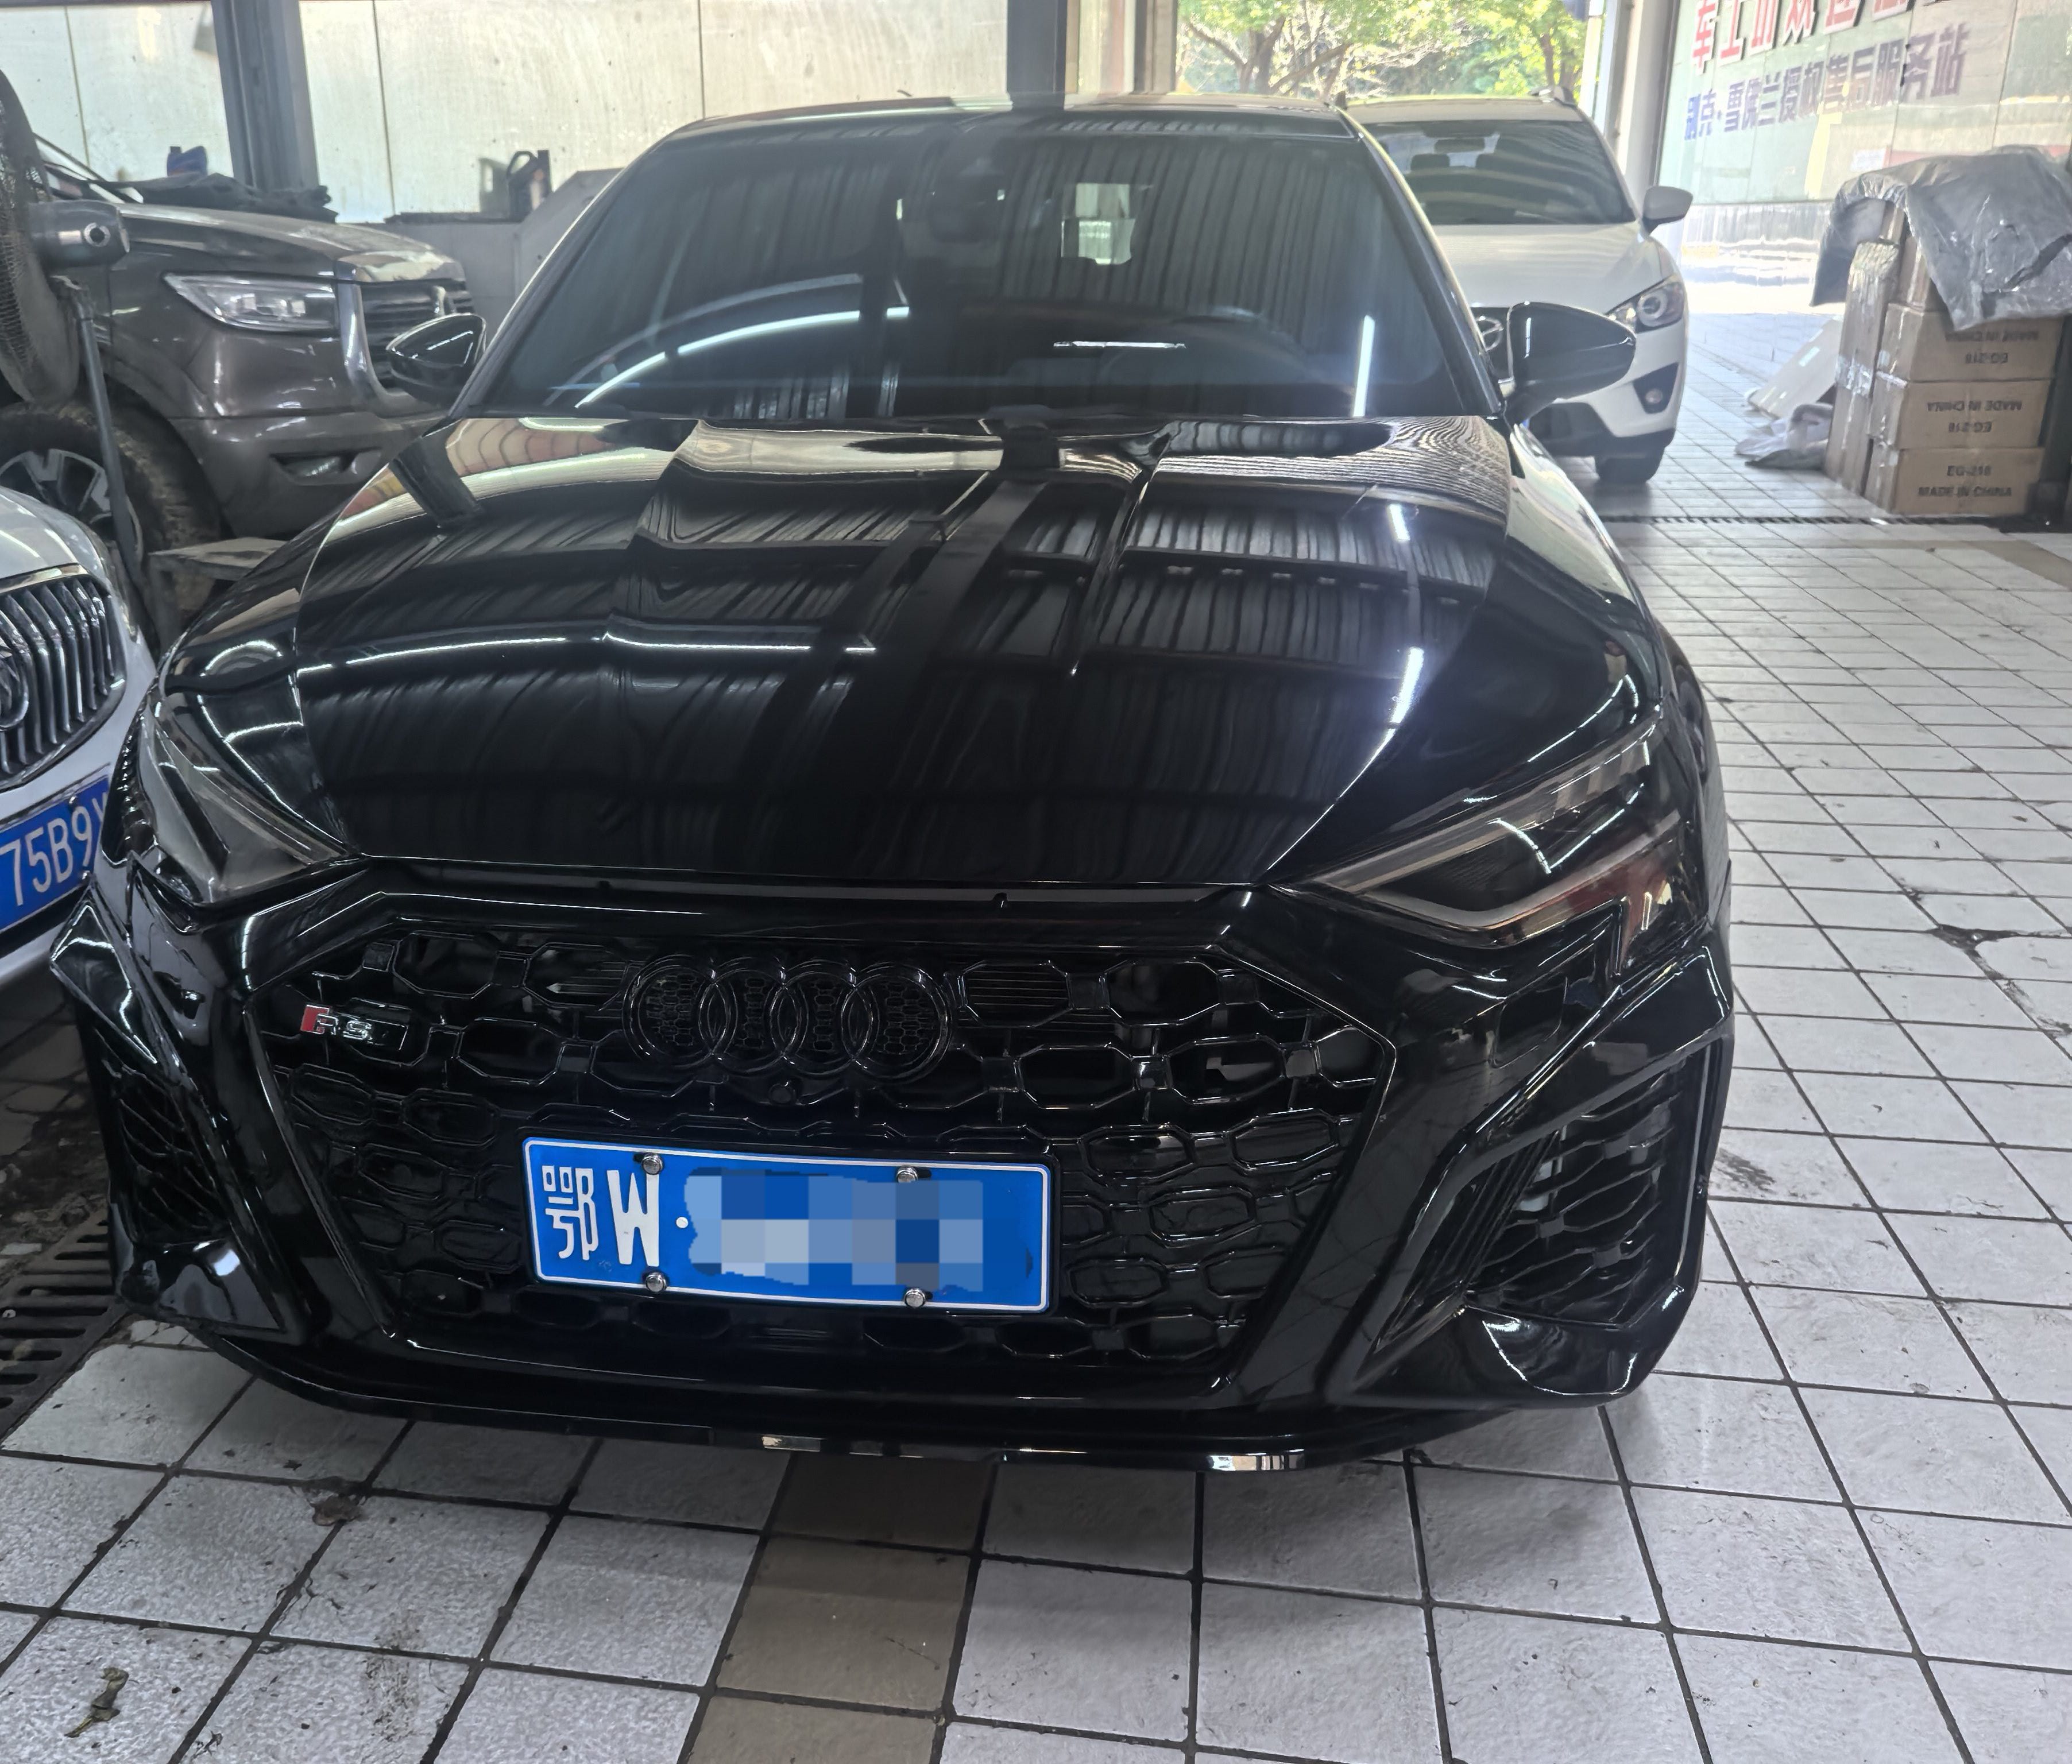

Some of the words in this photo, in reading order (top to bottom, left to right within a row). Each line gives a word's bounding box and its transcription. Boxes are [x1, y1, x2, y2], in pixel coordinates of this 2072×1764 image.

[1927, 401, 1965, 412] CHINA
[1969, 400, 1981, 411] IN
[1984, 400, 2023, 411] MADE
[1918, 487, 1953, 497] MADE
[1957, 486, 1970, 497] IN
[1973, 486, 2012, 497] CHINA
